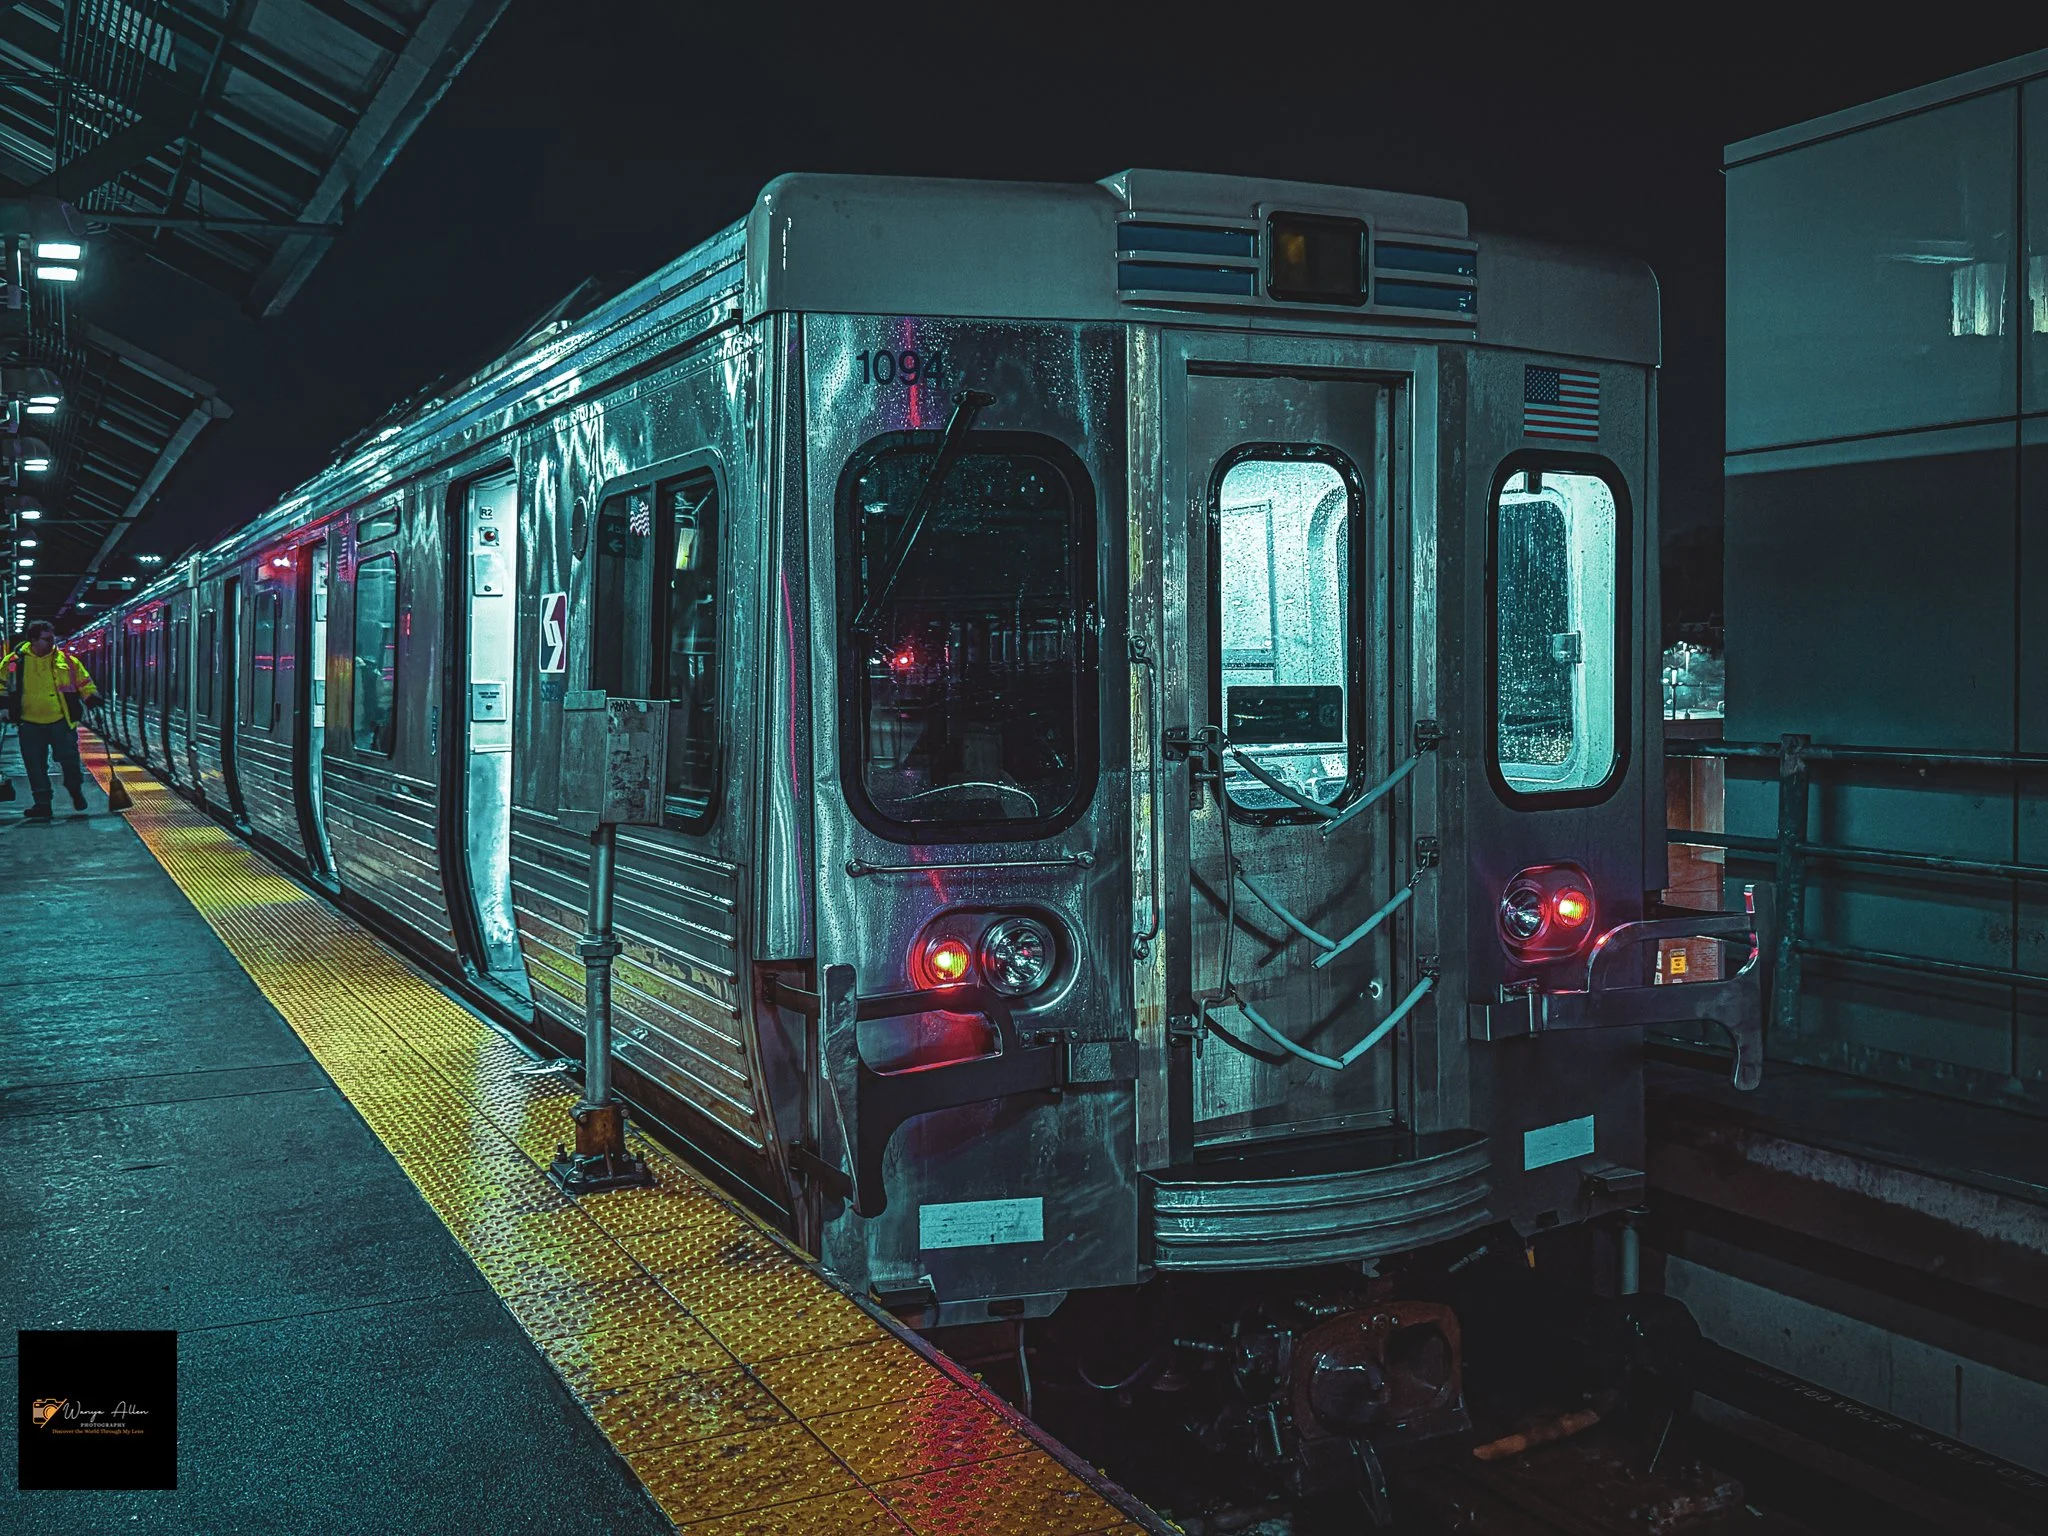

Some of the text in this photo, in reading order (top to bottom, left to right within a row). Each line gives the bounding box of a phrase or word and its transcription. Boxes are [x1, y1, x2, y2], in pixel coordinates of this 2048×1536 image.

[856, 350, 944, 387] 1094
[1833, 1401, 1903, 1429] VOLTS
[1929, 1441, 1995, 1466] KEEP
